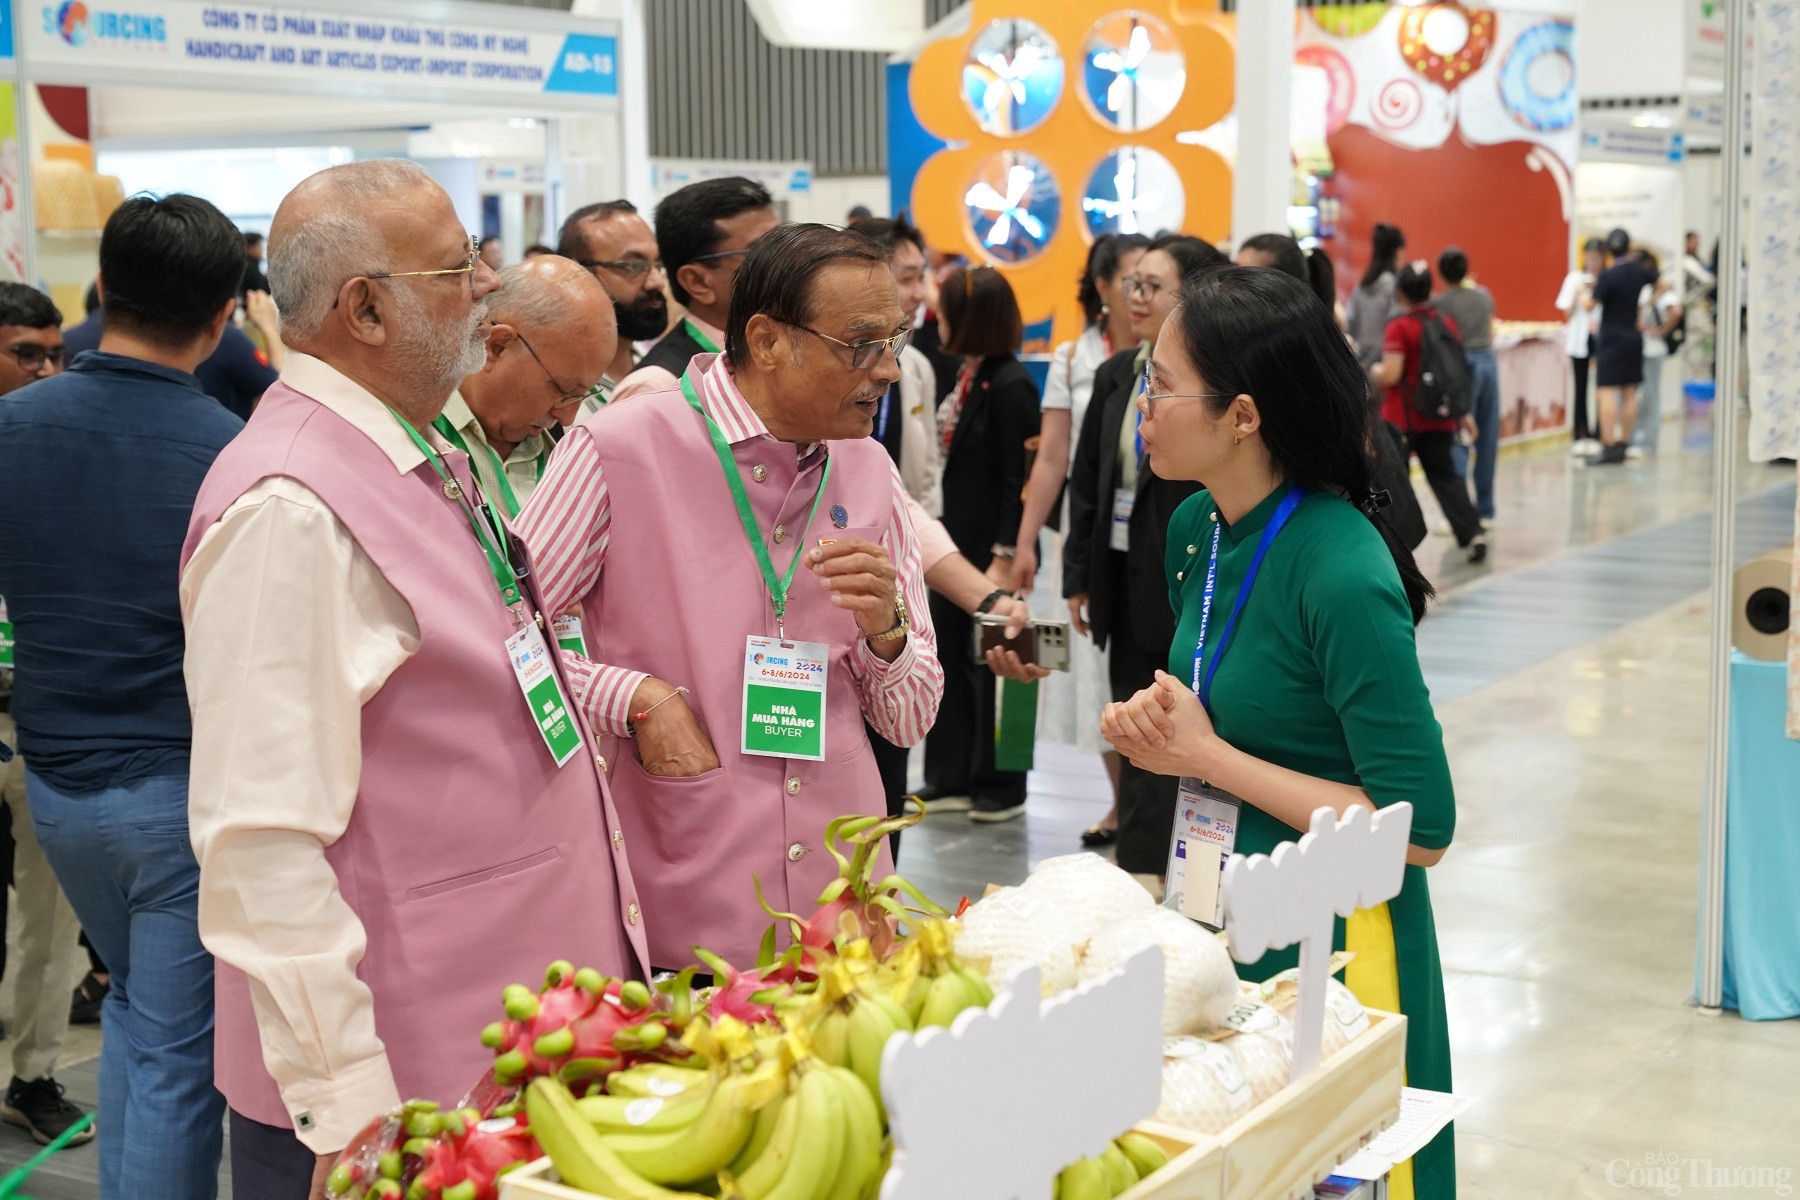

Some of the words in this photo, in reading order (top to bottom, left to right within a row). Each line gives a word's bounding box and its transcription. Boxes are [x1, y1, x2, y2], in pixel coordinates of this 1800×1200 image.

[1196, 595, 1212, 650] VIETNAM
[771, 704, 797, 716] NHÀ
[751, 713, 779, 725] MUA
[781, 715, 816, 728] HÀNG
[764, 725, 803, 738] BUYER
